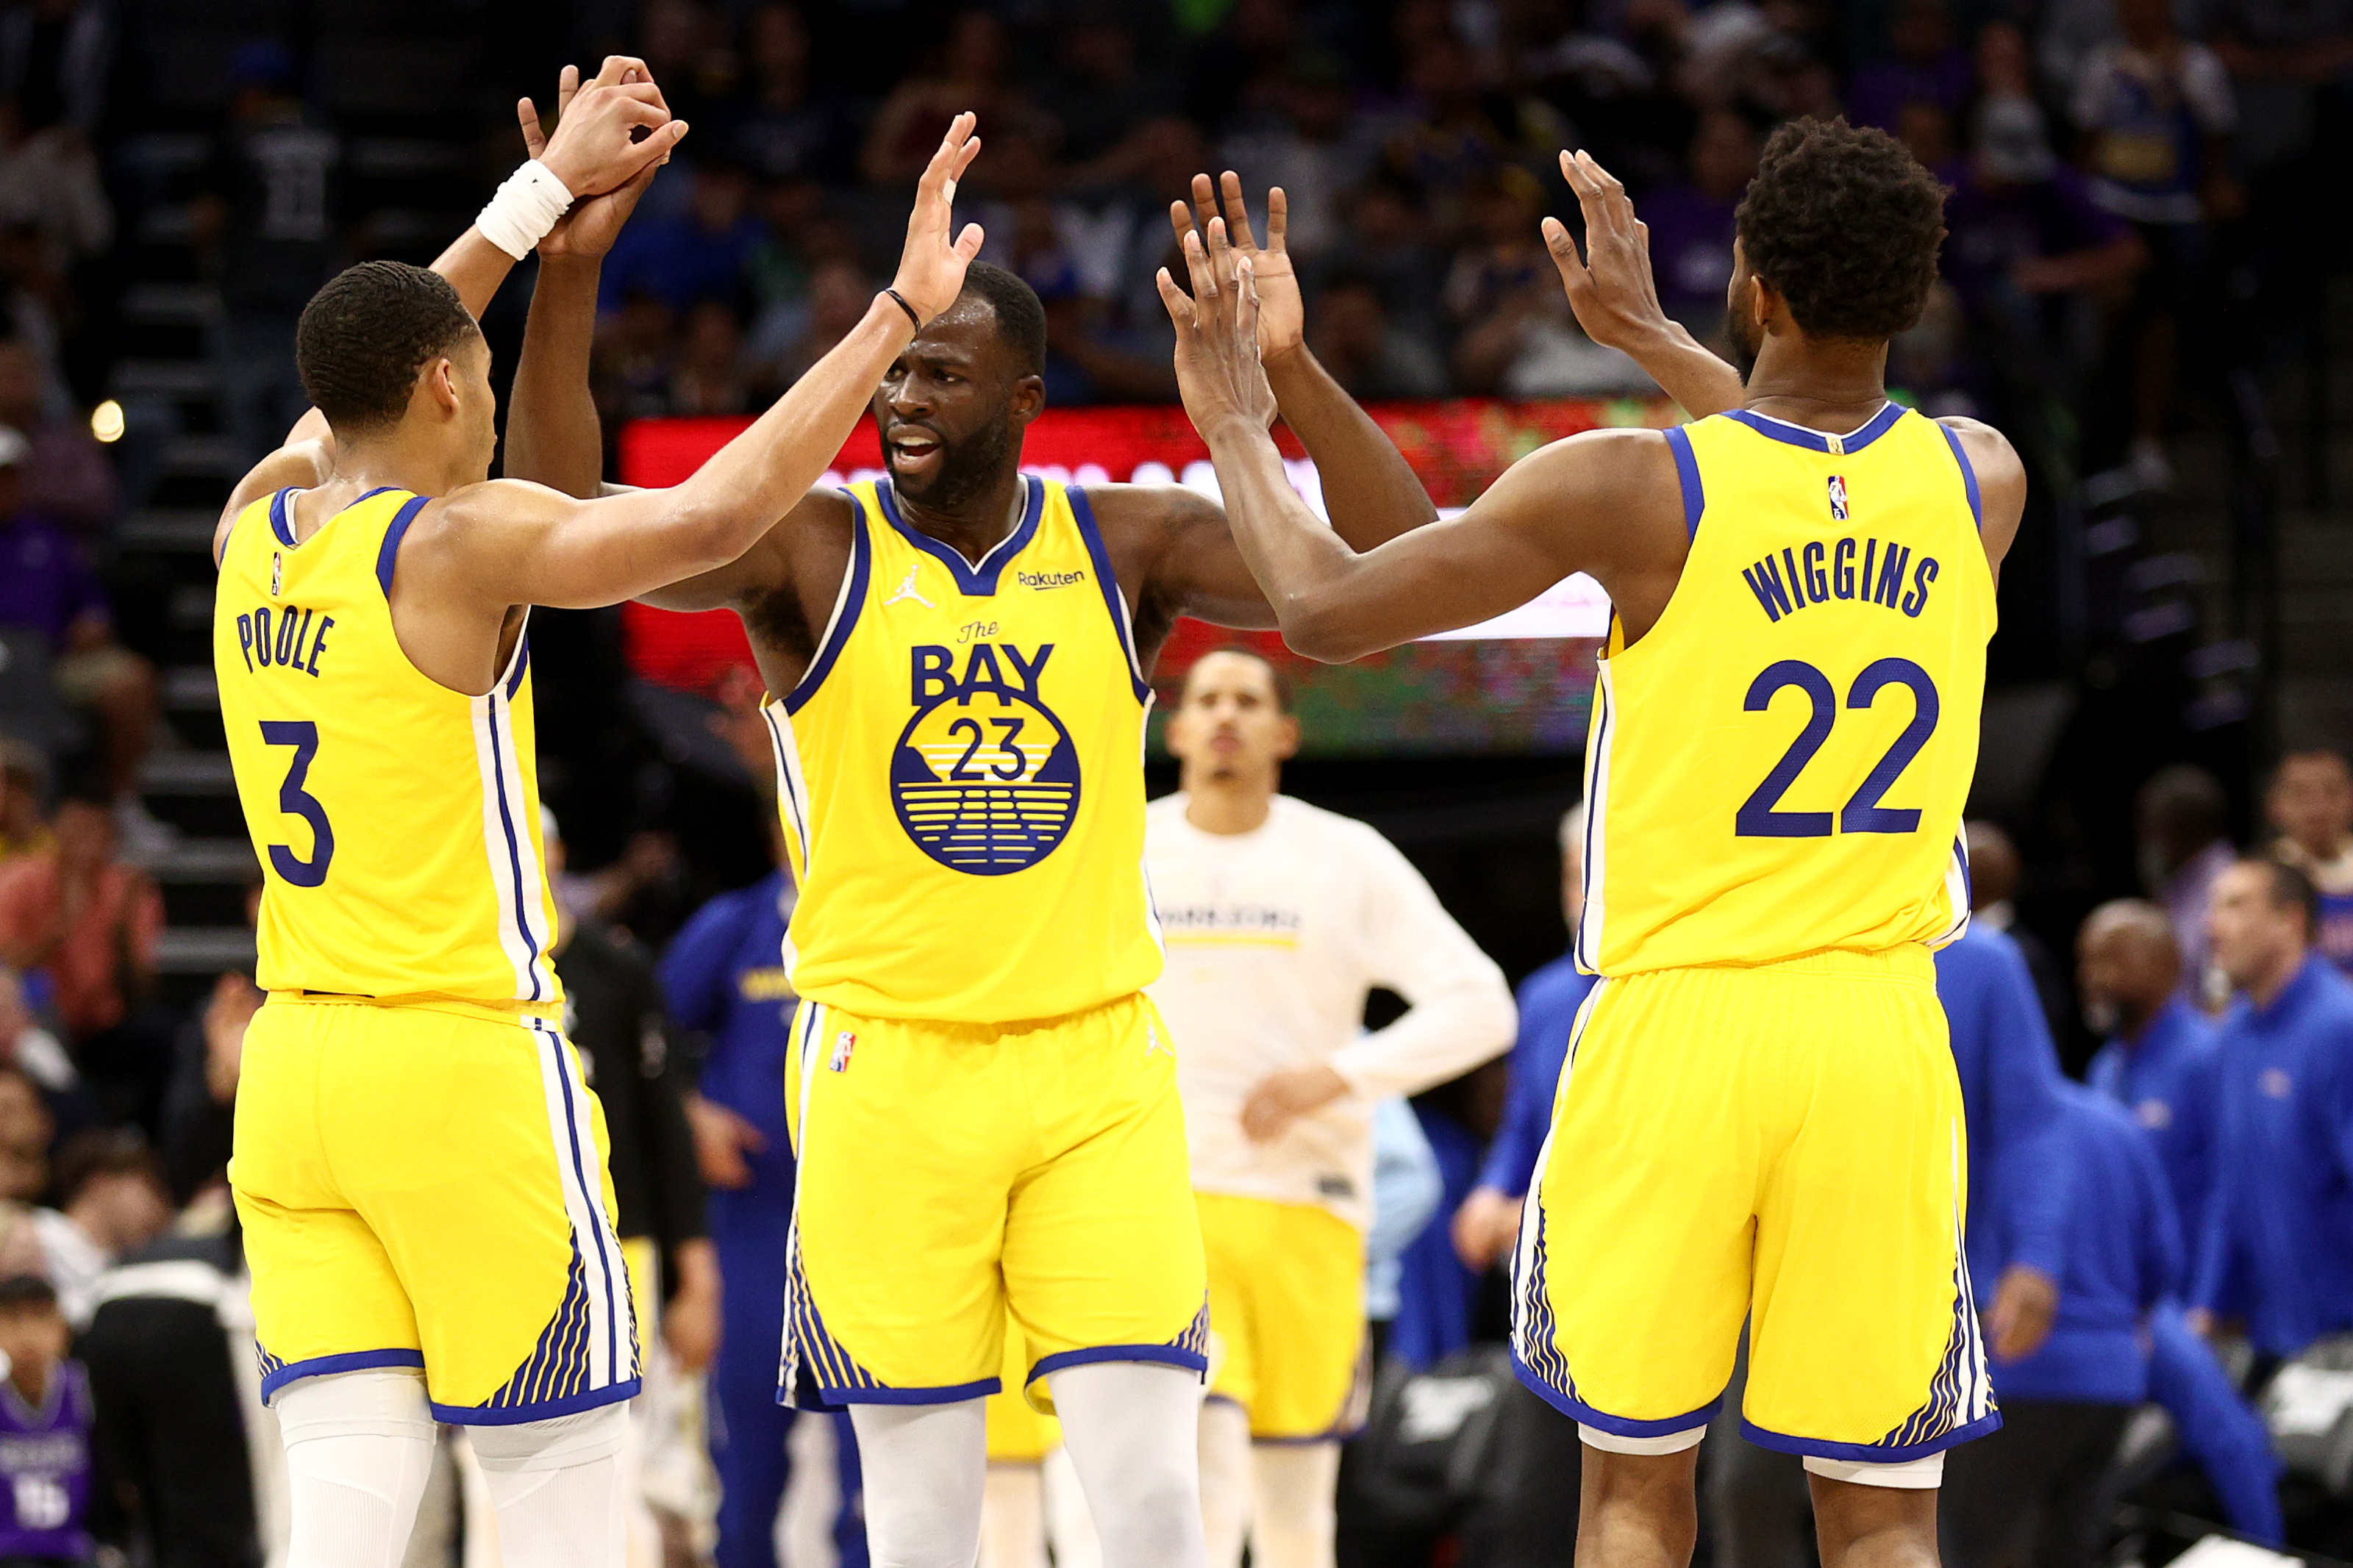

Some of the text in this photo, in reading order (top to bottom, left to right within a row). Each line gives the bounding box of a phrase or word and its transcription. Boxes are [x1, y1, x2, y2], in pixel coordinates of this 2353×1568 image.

[1018, 570, 1085, 586] Rakuten
[1741, 537, 1940, 623] WIGGINS
[237, 605, 335, 679] POOLE
[957, 620, 1000, 644] The
[911, 643, 1055, 706] BAY
[949, 717, 1026, 781] 23
[1735, 656, 1940, 838] 22
[258, 720, 335, 888] 3
